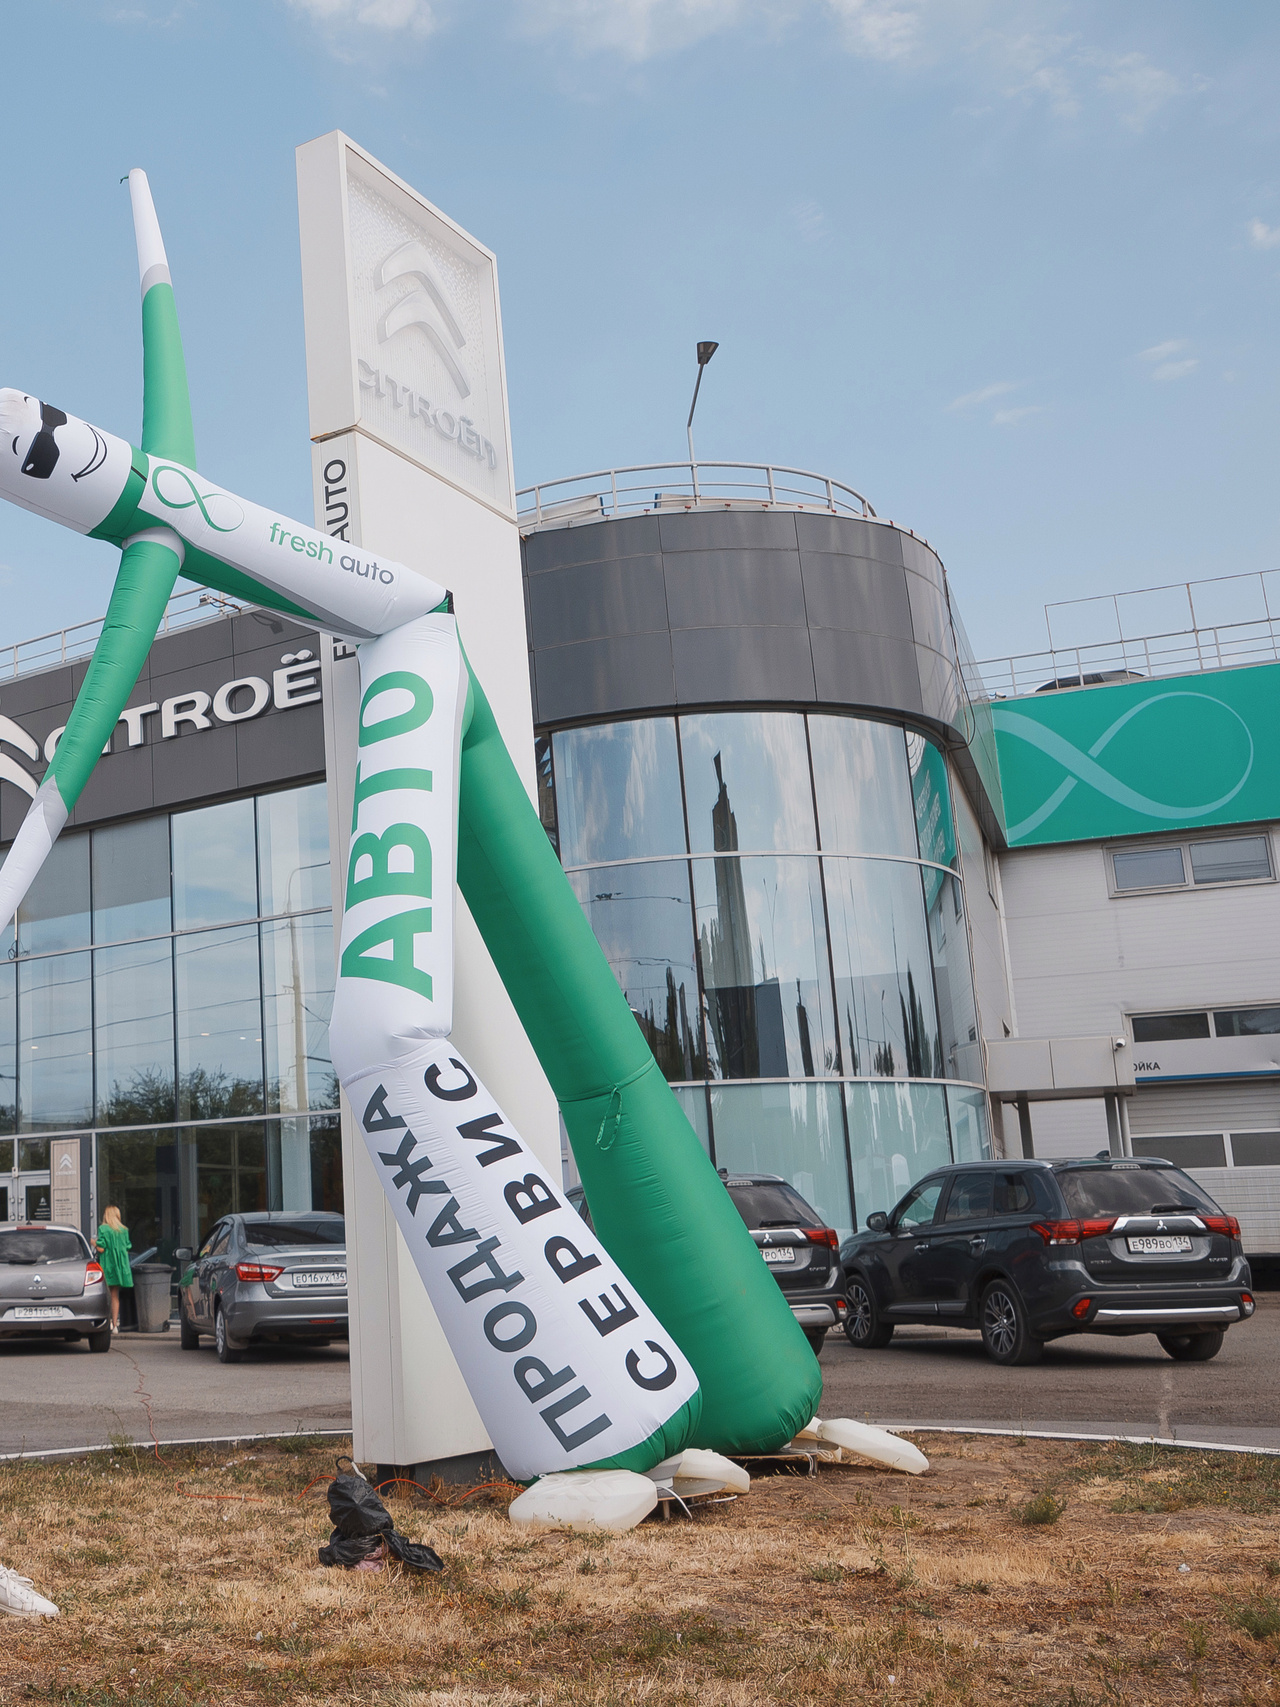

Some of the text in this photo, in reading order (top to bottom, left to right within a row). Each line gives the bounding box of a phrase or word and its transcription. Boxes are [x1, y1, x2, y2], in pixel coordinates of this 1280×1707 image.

[269, 522, 395, 585] fresh auto
[324, 459, 350, 543] AUTO
[44, 649, 322, 764] TROË
[340, 670, 434, 1003] АВТО
[362, 1084, 613, 1453] ПРОДАЖА
[424, 1057, 677, 1392] СЕРВИС
